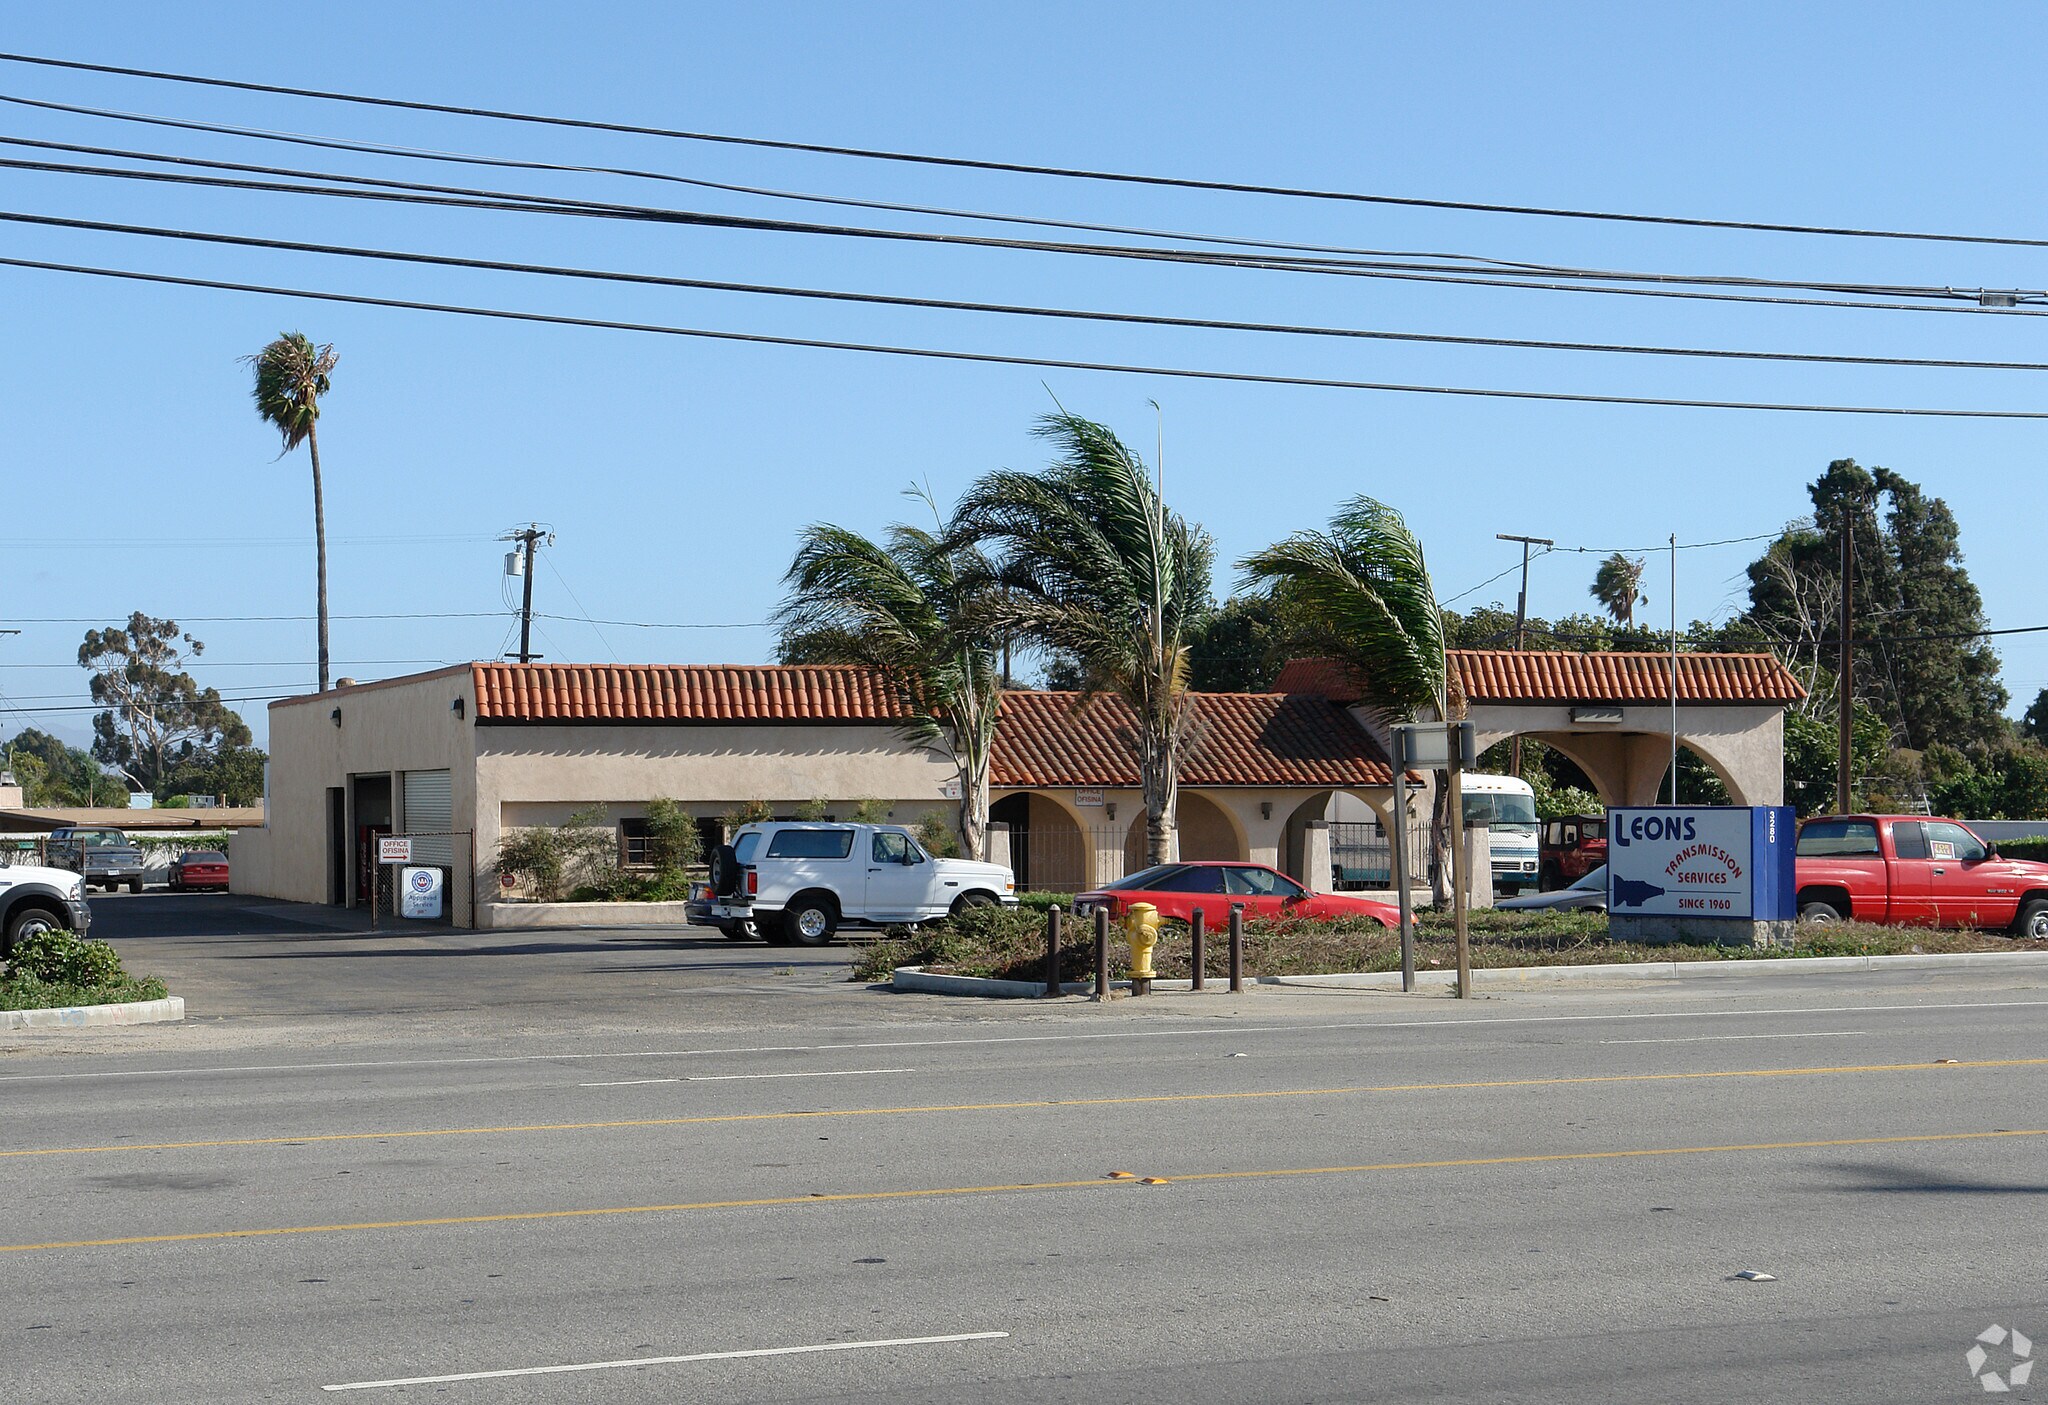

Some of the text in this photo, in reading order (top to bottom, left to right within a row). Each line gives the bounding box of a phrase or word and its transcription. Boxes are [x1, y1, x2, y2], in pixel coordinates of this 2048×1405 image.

[1615, 814, 1696, 847] LEONS
[1665, 844, 1743, 879] TRANSMISSION
[1678, 872, 1727, 884] SERVICES
[1678, 899, 1731, 910] SINCE 1960
